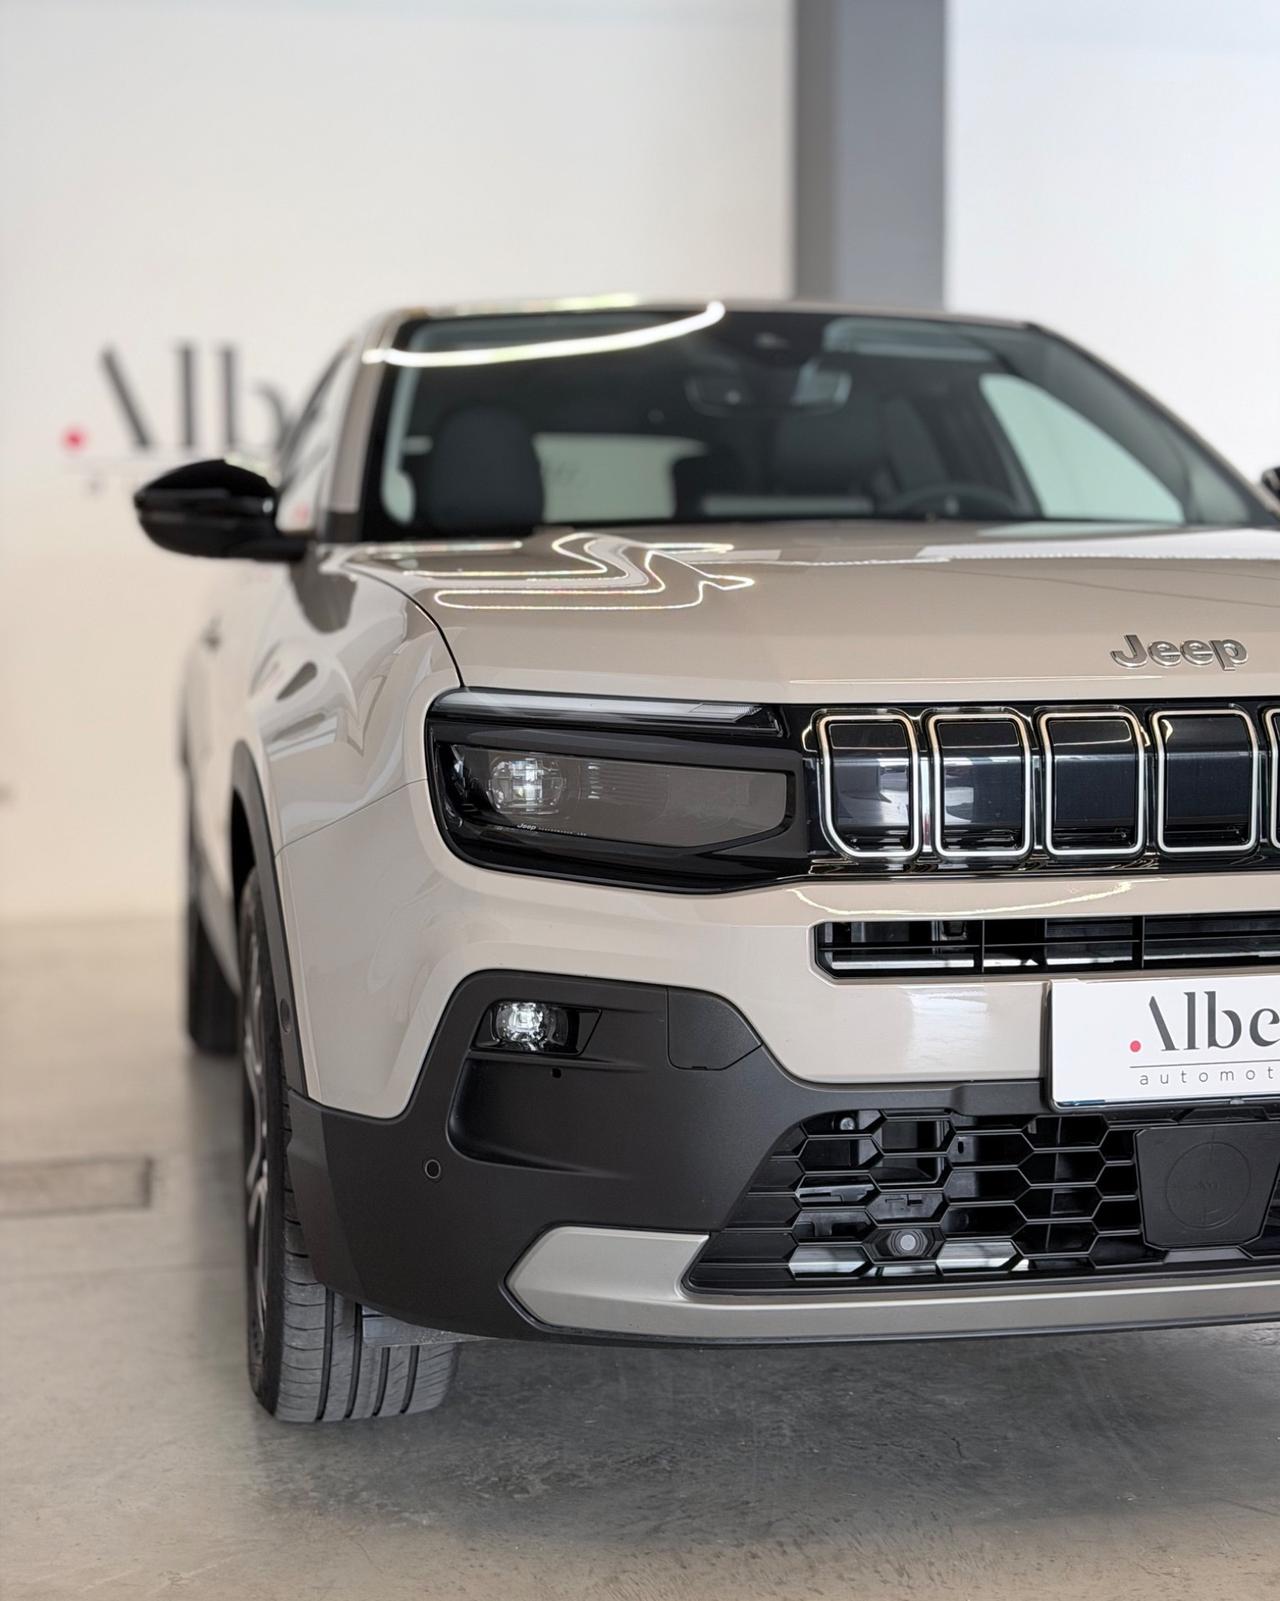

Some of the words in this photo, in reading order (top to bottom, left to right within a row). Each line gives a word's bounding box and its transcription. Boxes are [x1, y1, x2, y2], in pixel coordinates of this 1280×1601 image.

[1110, 634, 1249, 671] Jeep
[517, 823, 537, 831] Jeep
[1139, 1066, 1274, 1086] automot
